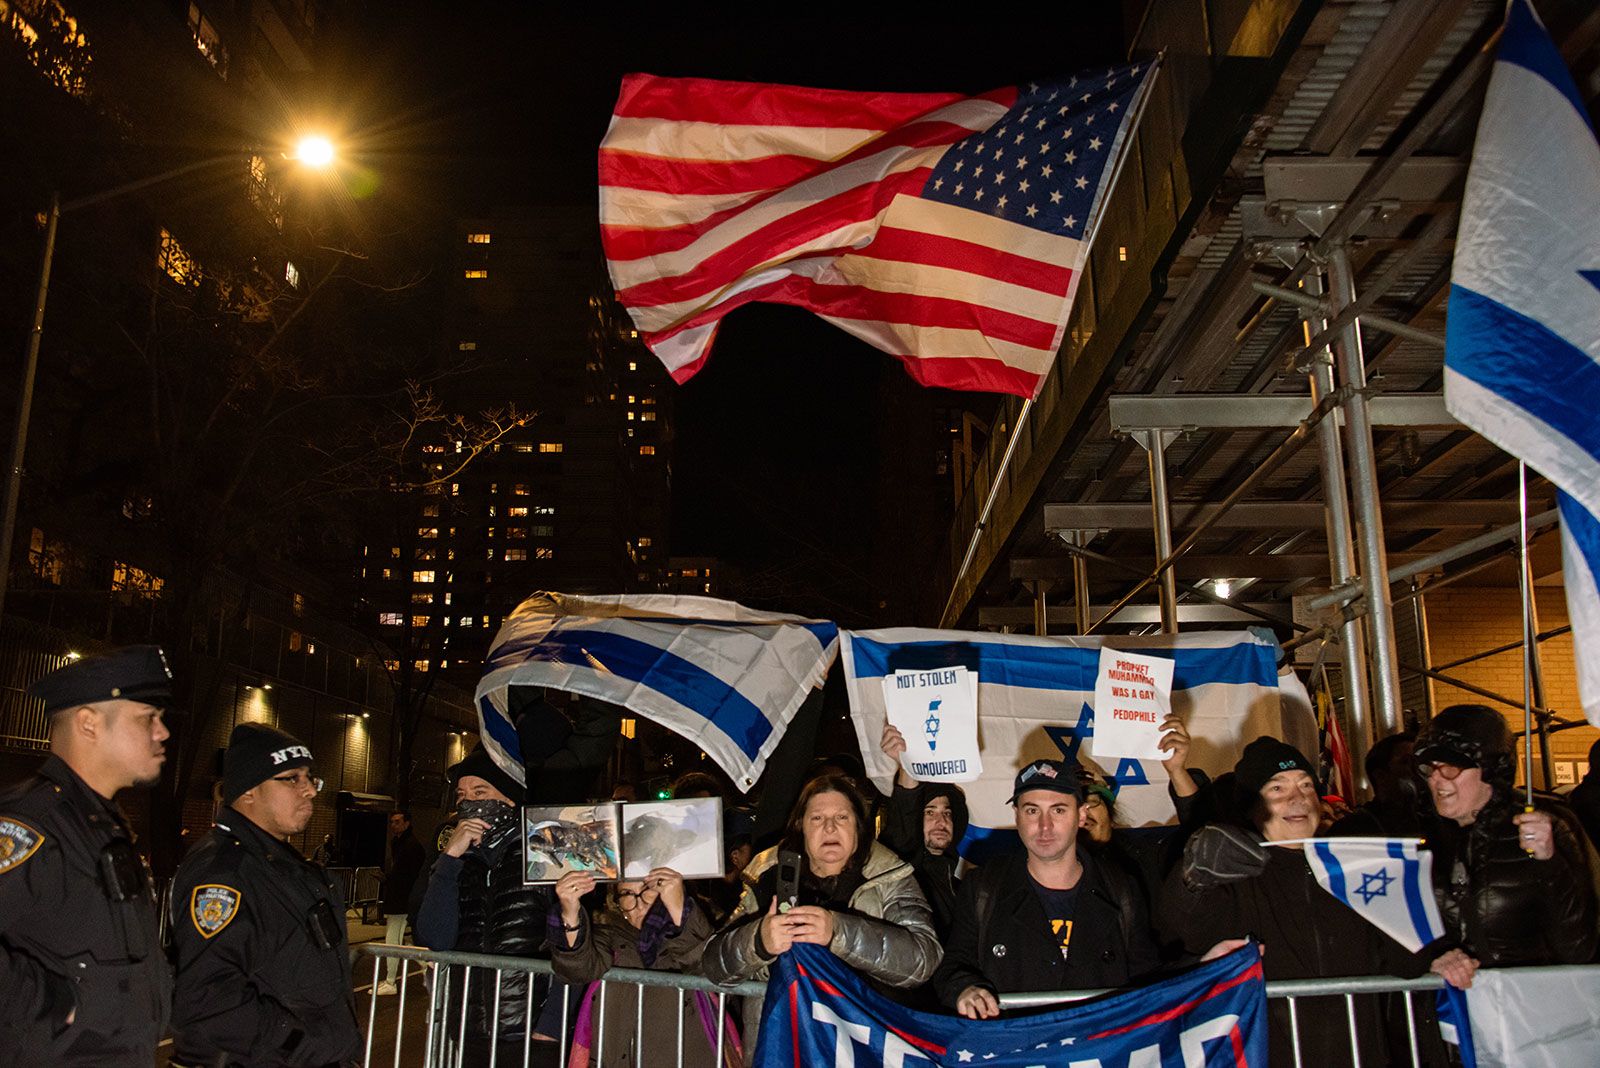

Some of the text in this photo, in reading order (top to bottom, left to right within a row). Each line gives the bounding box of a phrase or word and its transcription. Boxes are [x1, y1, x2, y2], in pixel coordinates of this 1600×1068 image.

[1116, 660, 1149, 675] PROPHET
[896, 670, 957, 689] NOT STOLEN
[1112, 686, 1155, 700] WAS A GAY
[1113, 709, 1156, 723] PEDOPHILE
[270, 745, 313, 765] NYP
[911, 759, 967, 776] CONQUERED
